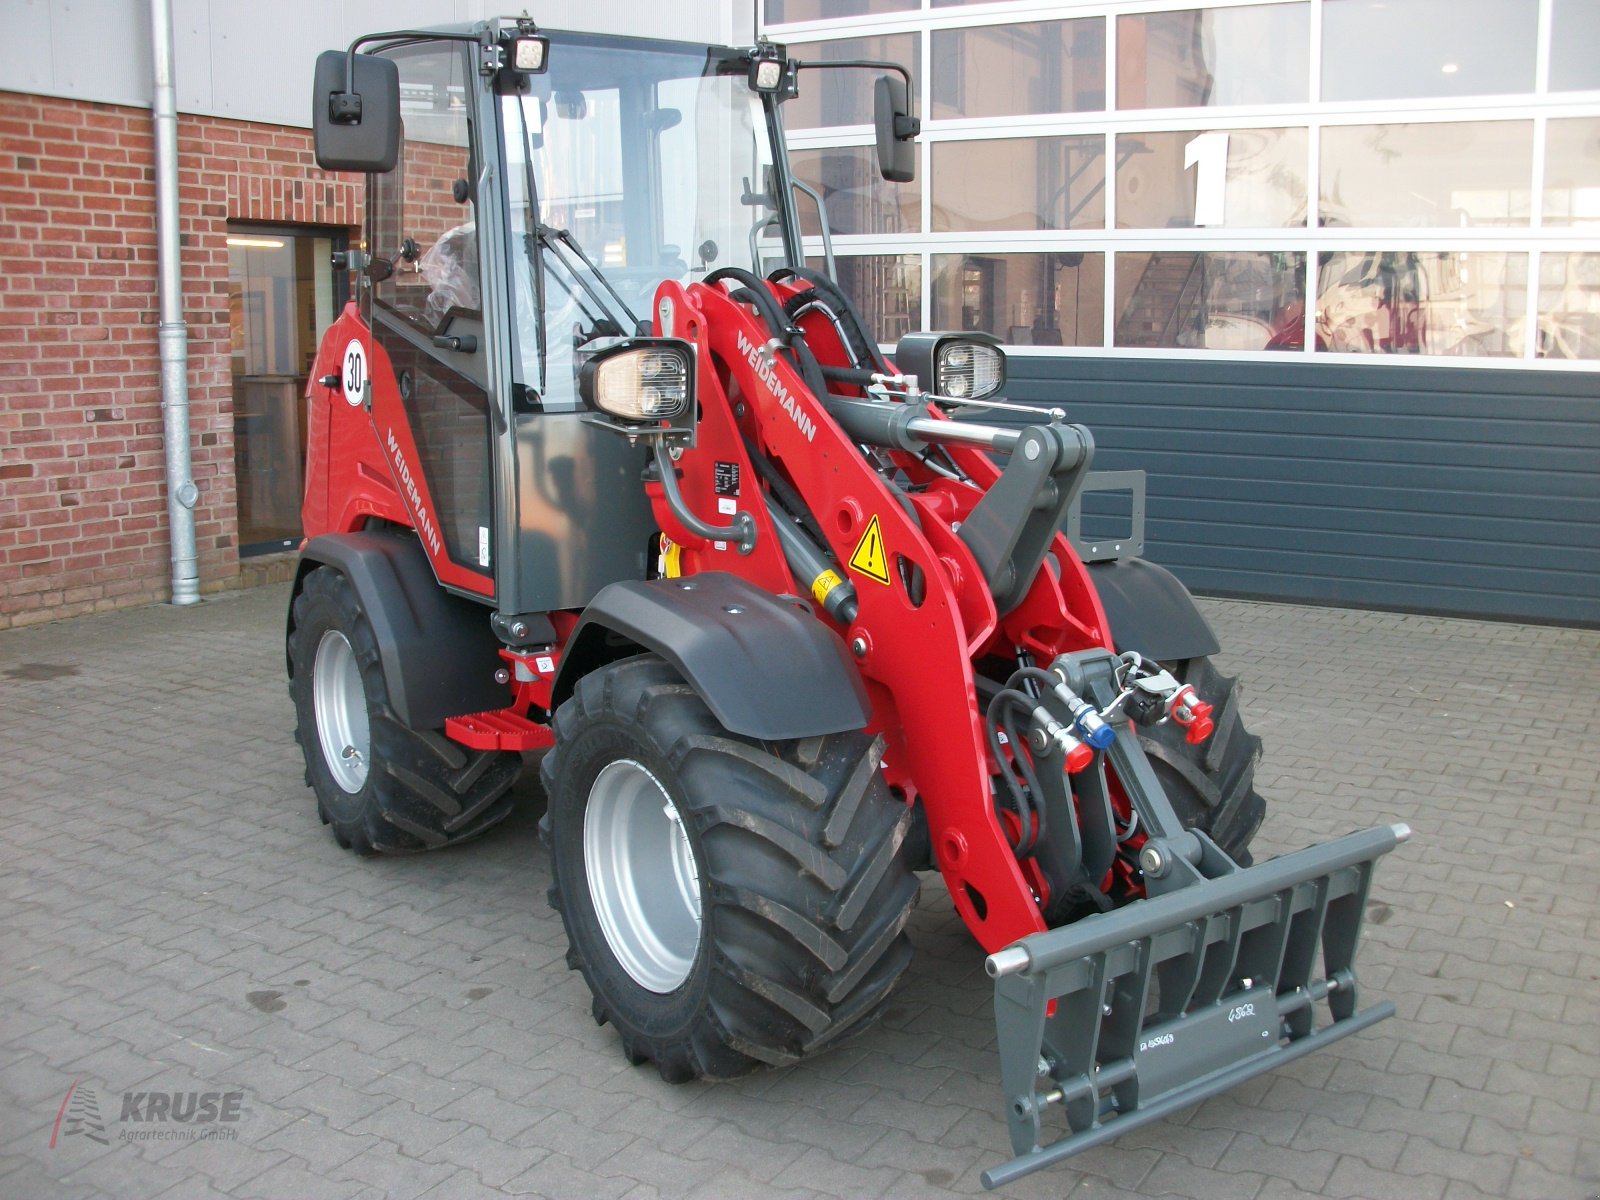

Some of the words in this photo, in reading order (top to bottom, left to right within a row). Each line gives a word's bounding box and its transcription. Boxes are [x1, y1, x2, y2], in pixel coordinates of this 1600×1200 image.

[1184, 133, 1229, 226] 1
[347, 352, 362, 393] 30
[737, 329, 817, 443] WEIDEMANN
[387, 427, 441, 557] WEIDEMANN
